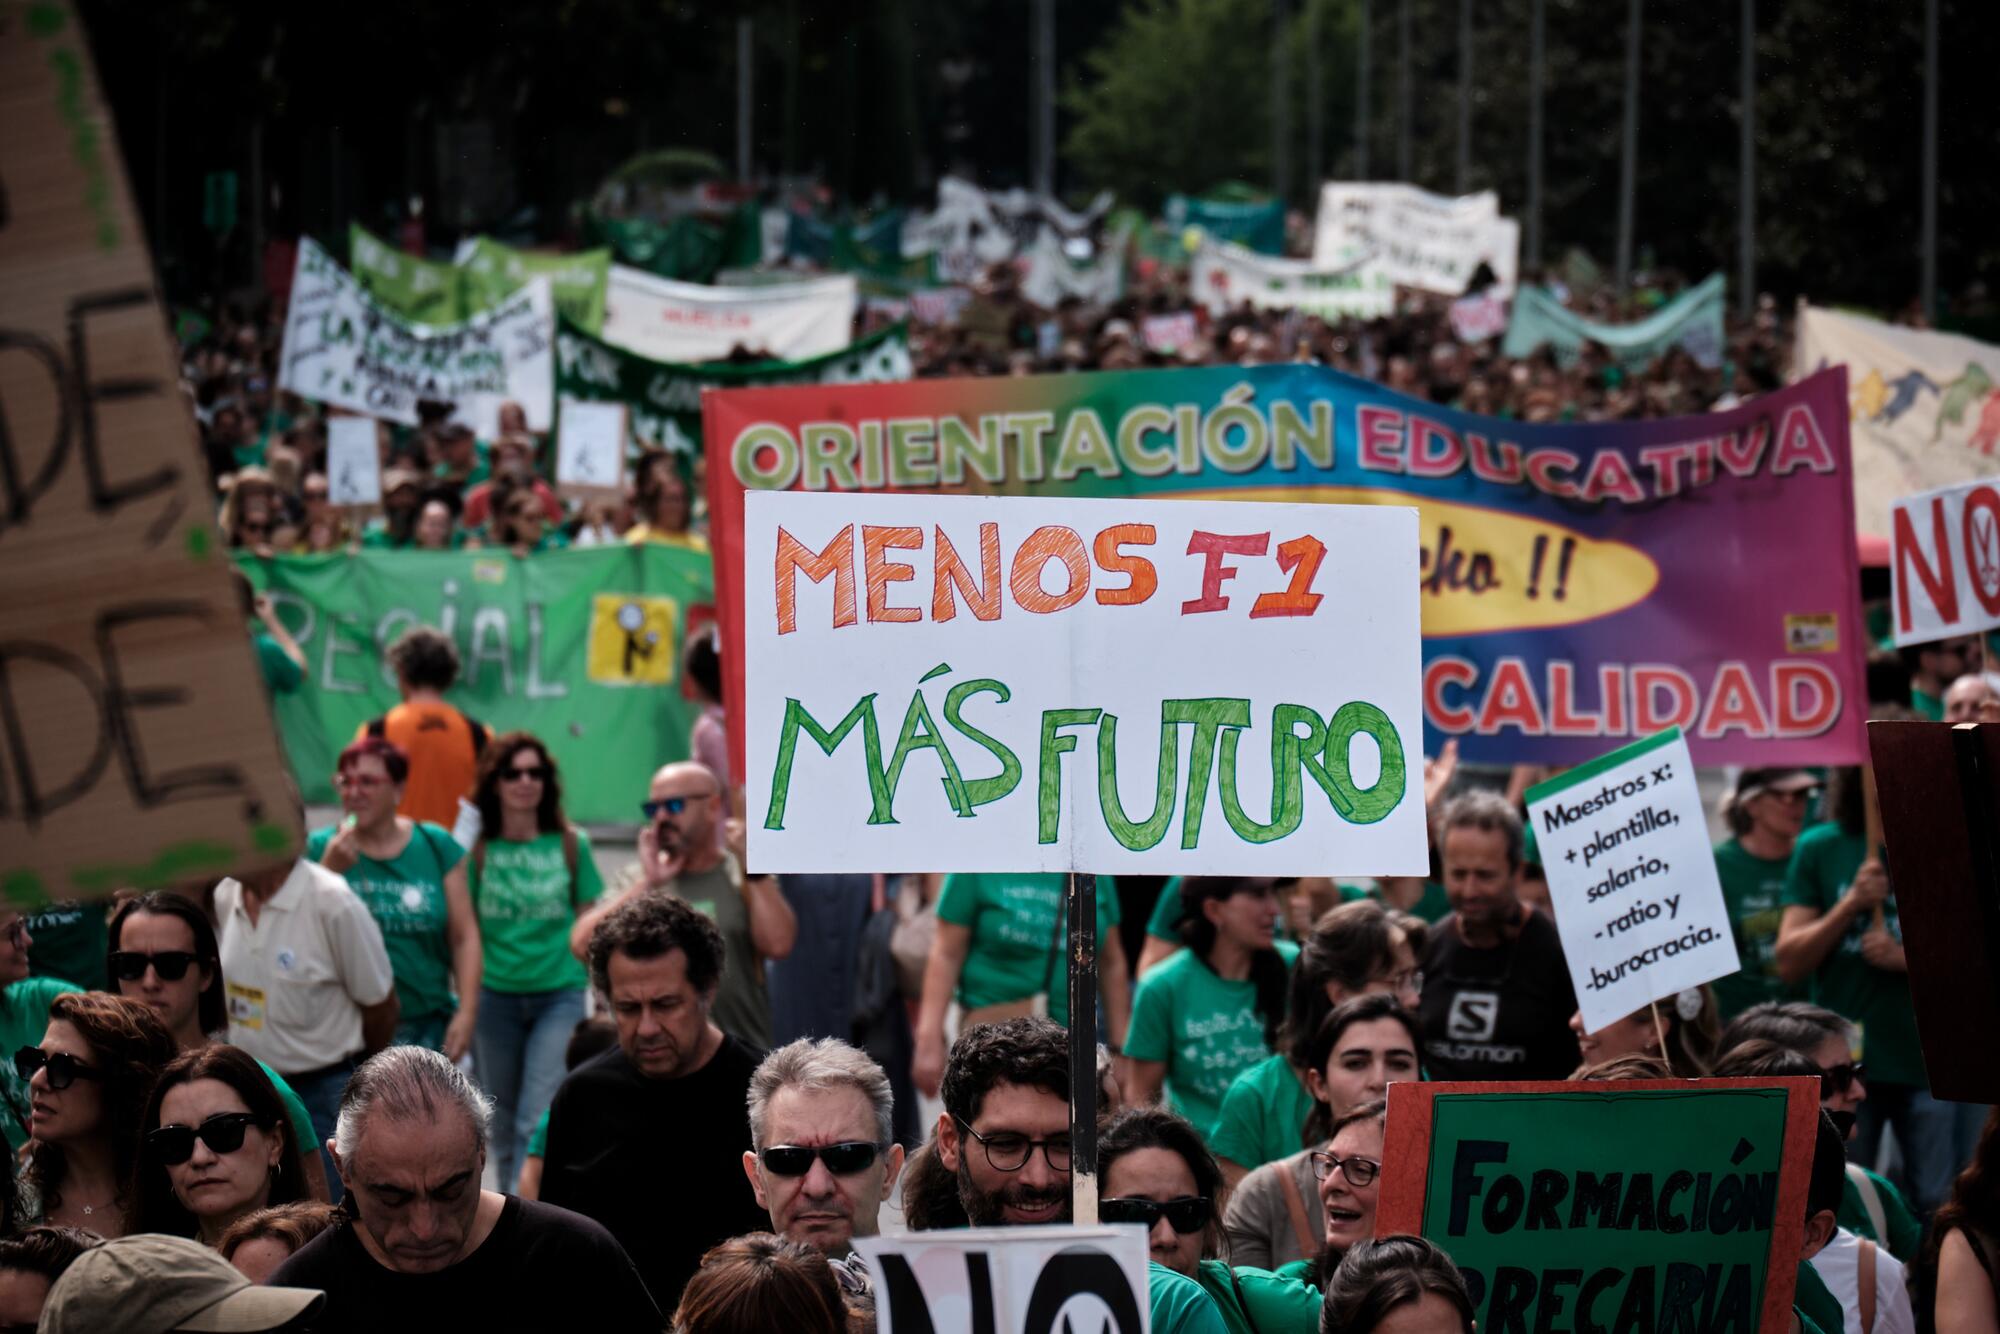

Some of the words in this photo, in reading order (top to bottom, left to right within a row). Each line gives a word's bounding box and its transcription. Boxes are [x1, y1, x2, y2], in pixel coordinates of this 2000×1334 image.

[731, 382, 1334, 491] ORIENTACIÓN
[1356, 403, 1836, 502] EDUCATIVA
[777, 522, 1158, 635] MENOS
[1181, 530, 1329, 619] F1
[1421, 656, 1842, 738] CALIDAD
[763, 662, 1023, 831] MÁS
[1038, 697, 1406, 853] FUTURO
[1543, 775, 1647, 834] Maestros
[1651, 762, 1674, 786] x:
[1582, 806, 1681, 868] plantilla,
[1586, 855, 1671, 904] salario,
[1606, 899, 1661, 938] ratio
[1667, 893, 1681, 920] y
